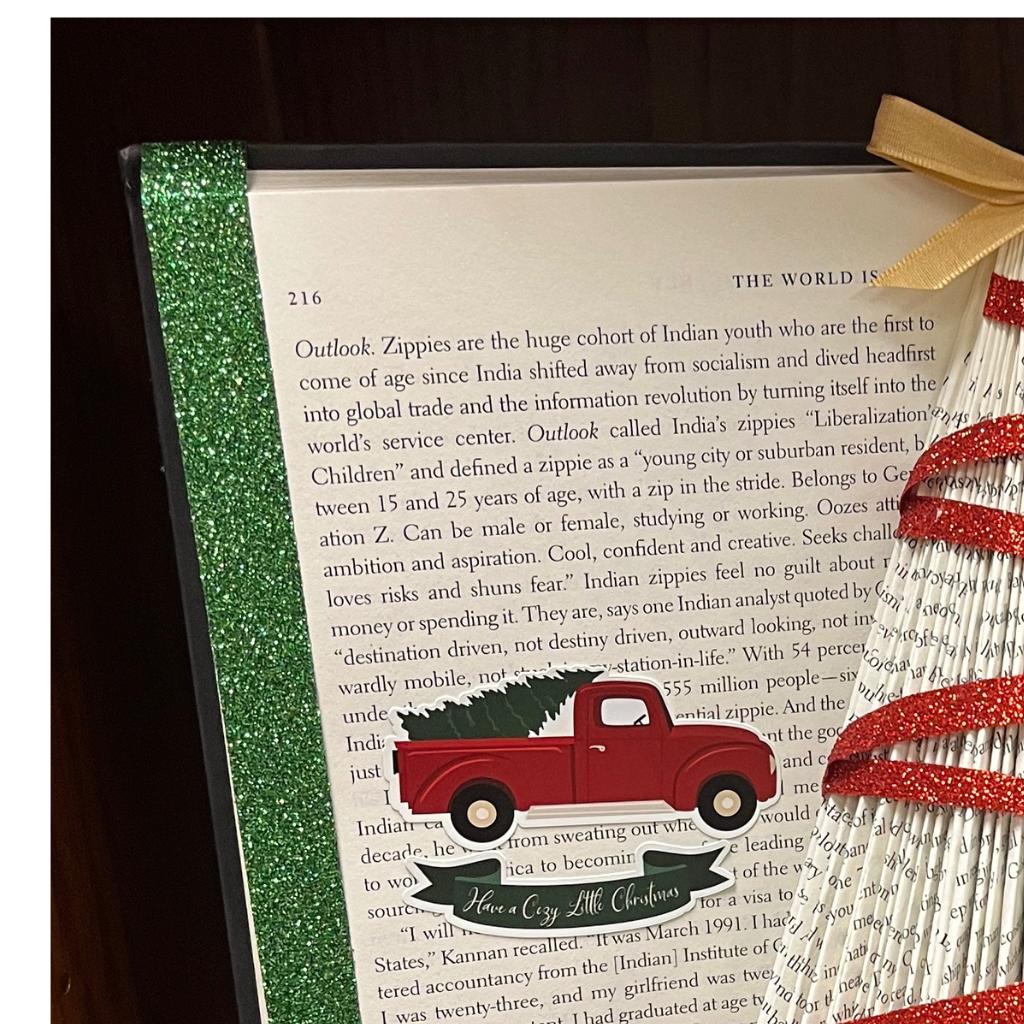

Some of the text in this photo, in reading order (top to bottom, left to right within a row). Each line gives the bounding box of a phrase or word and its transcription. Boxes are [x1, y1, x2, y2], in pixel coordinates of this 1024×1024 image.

[288, 291, 322, 305] 216
[732, 274, 773, 288] THE
[781, 271, 853, 286] WORLD
[295, 314, 934, 360] Outlook. Zippies are the huge cohort of Indian youth who are the first to
[304, 373, 937, 427] into global trade and the information revolution by turning itself into the
[326, 555, 875, 607] loves risks and shuns fear.” Indian zippies feel no guilt about
[700, 668, 820, 694] million people
[554, 824, 659, 844] sweating out
[462, 881, 679, 928] Have a Cozy Little Christmas
[378, 938, 770, 1000] tered accountancy from the [Indian] Institute of
